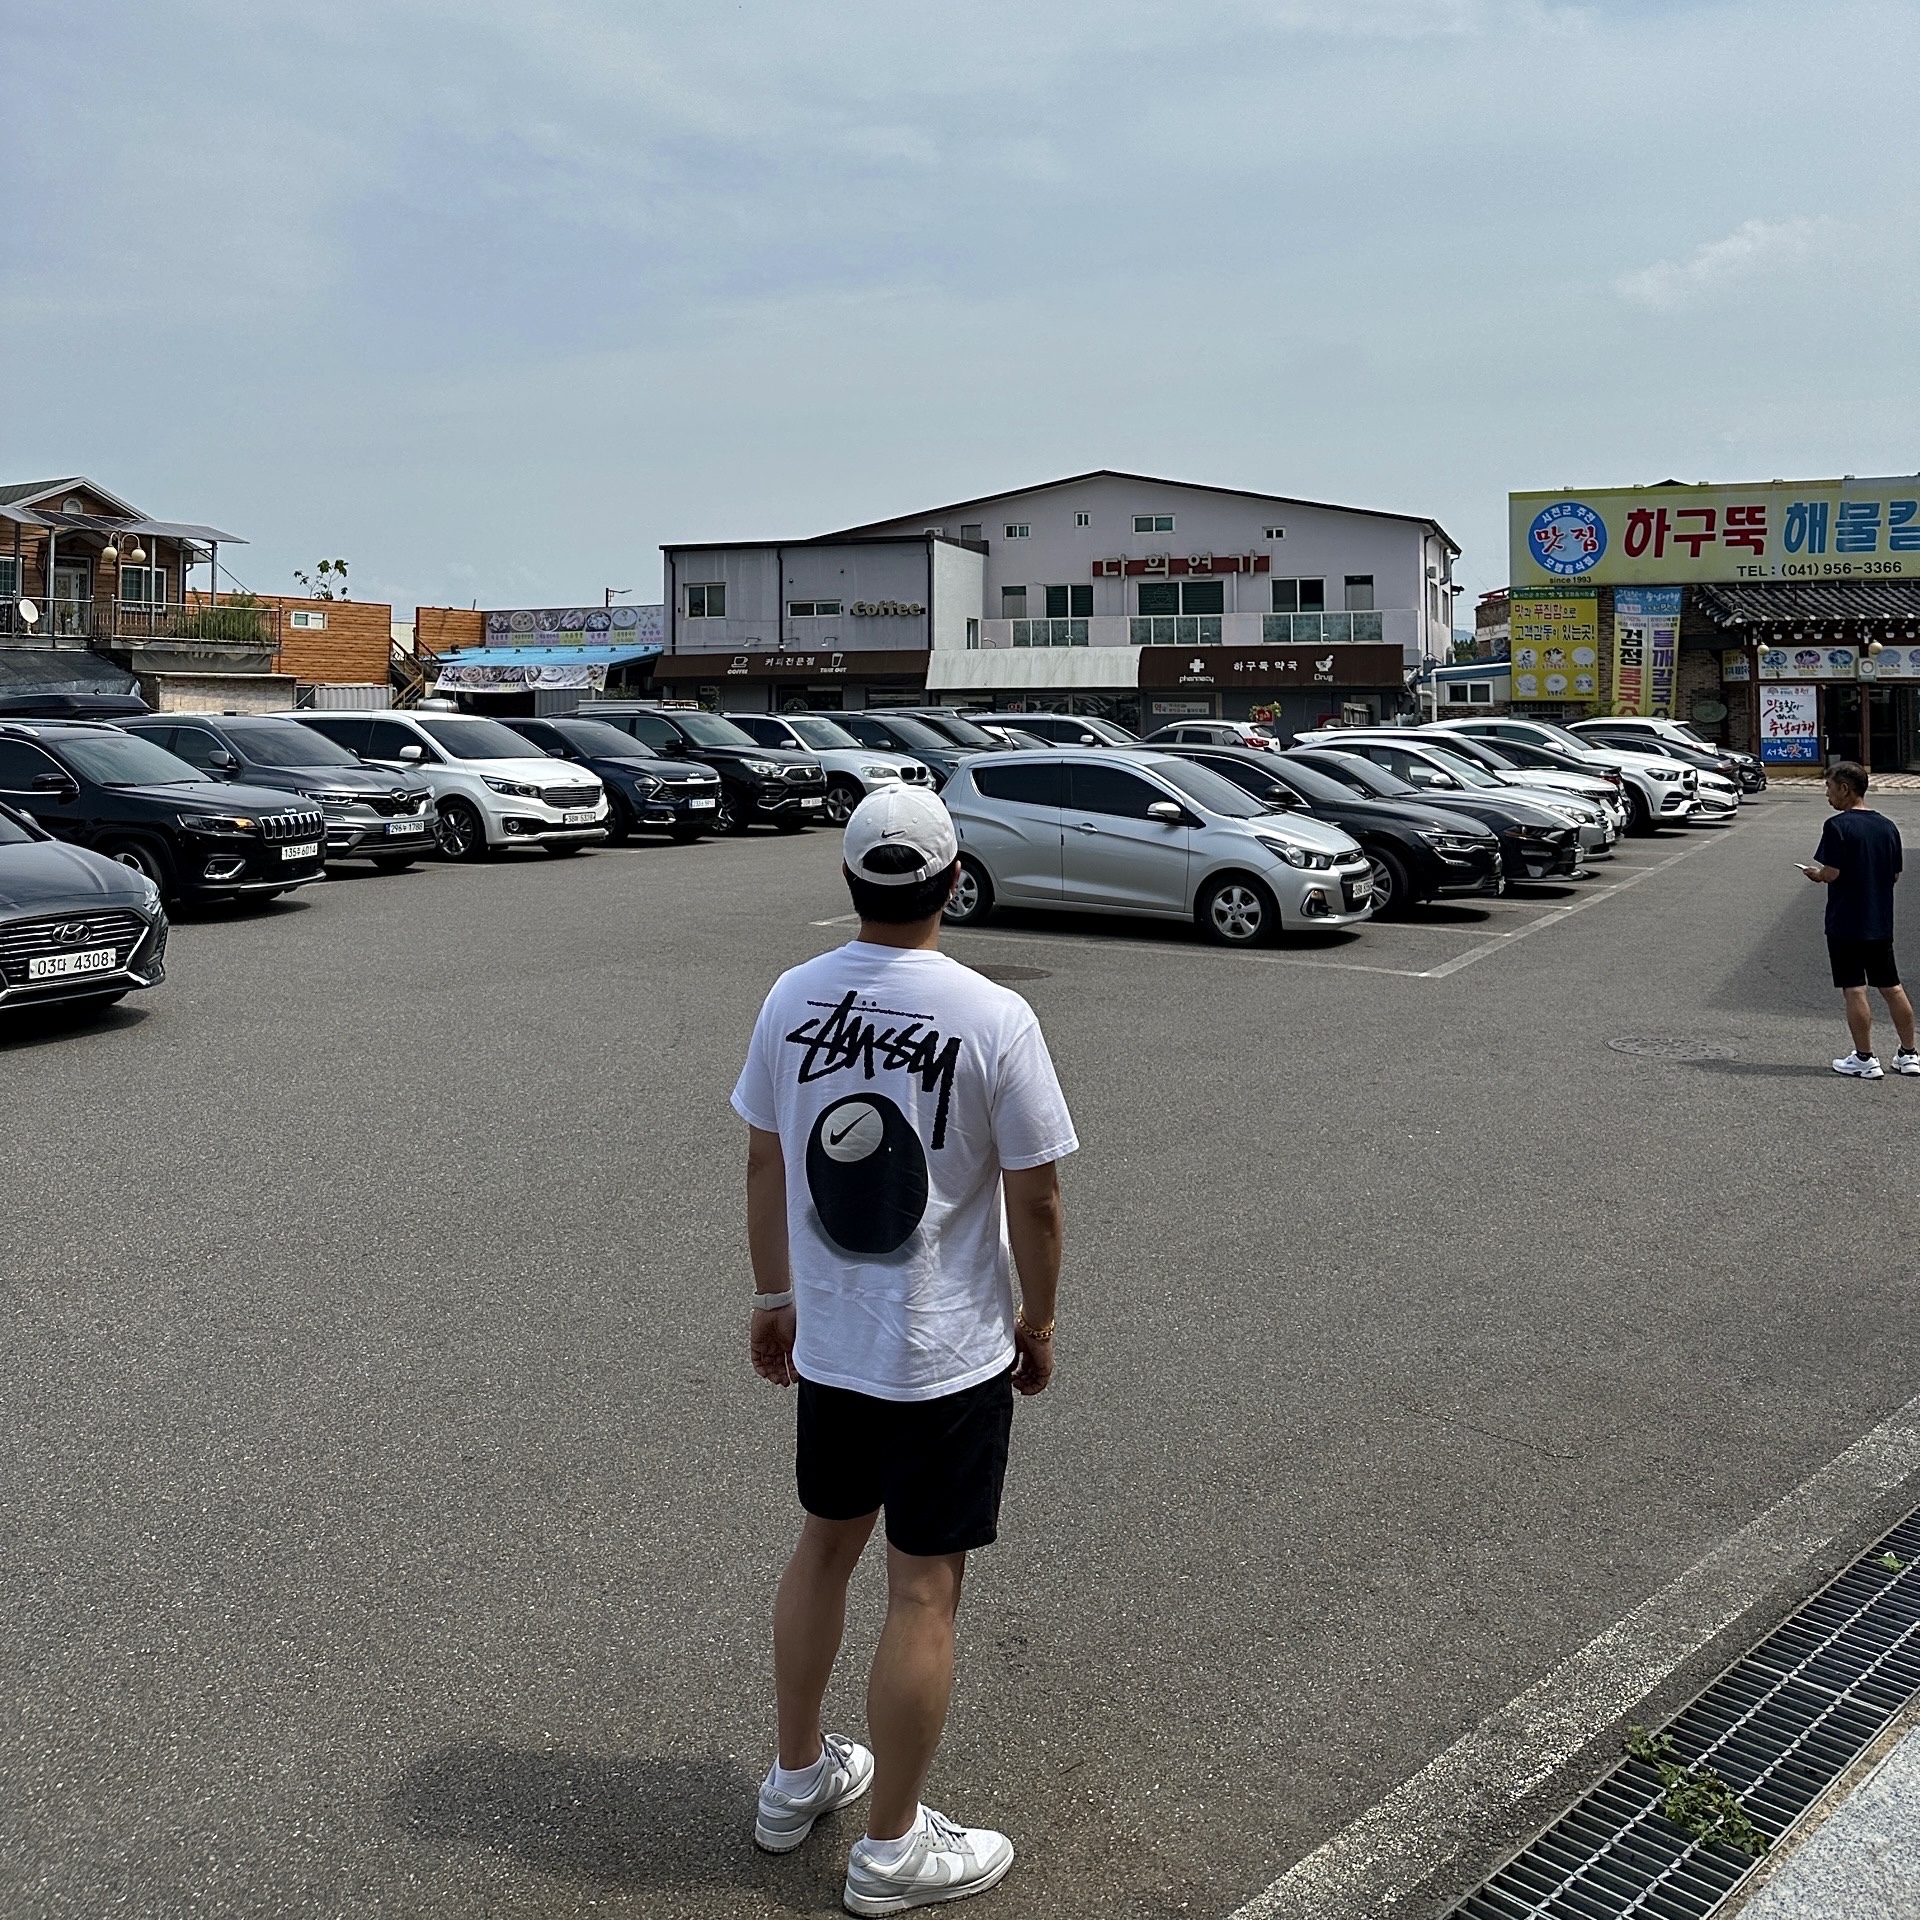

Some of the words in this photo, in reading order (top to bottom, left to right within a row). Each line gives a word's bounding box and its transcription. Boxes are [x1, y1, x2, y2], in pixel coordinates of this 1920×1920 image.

[1541, 505, 1572, 523] 서천군
[1623, 504, 1768, 558] 하구뚝
[1781, 562, 1819, 577] (041)
[1823, 561, 1902, 575] 956-3366
[1549, 576, 1571, 584] since
[1572, 576, 1592, 584] 1993
[852, 600, 921, 617] Coffee
[1514, 604, 1532, 620] 맛과
[1534, 603, 1577, 620] 푸짐함으로
[1515, 625, 1560, 641] 고객감동이
[1562, 624, 1595, 641] 있는곳!
[764, 657, 815, 667] 커피전문점
[1274, 660, 1298, 672] 약국
[1313, 673, 1334, 682] Drug
[1769, 718, 1815, 737] 충남여행
[38, 958, 67, 975] 03다
[74, 952, 109, 970] 4308
